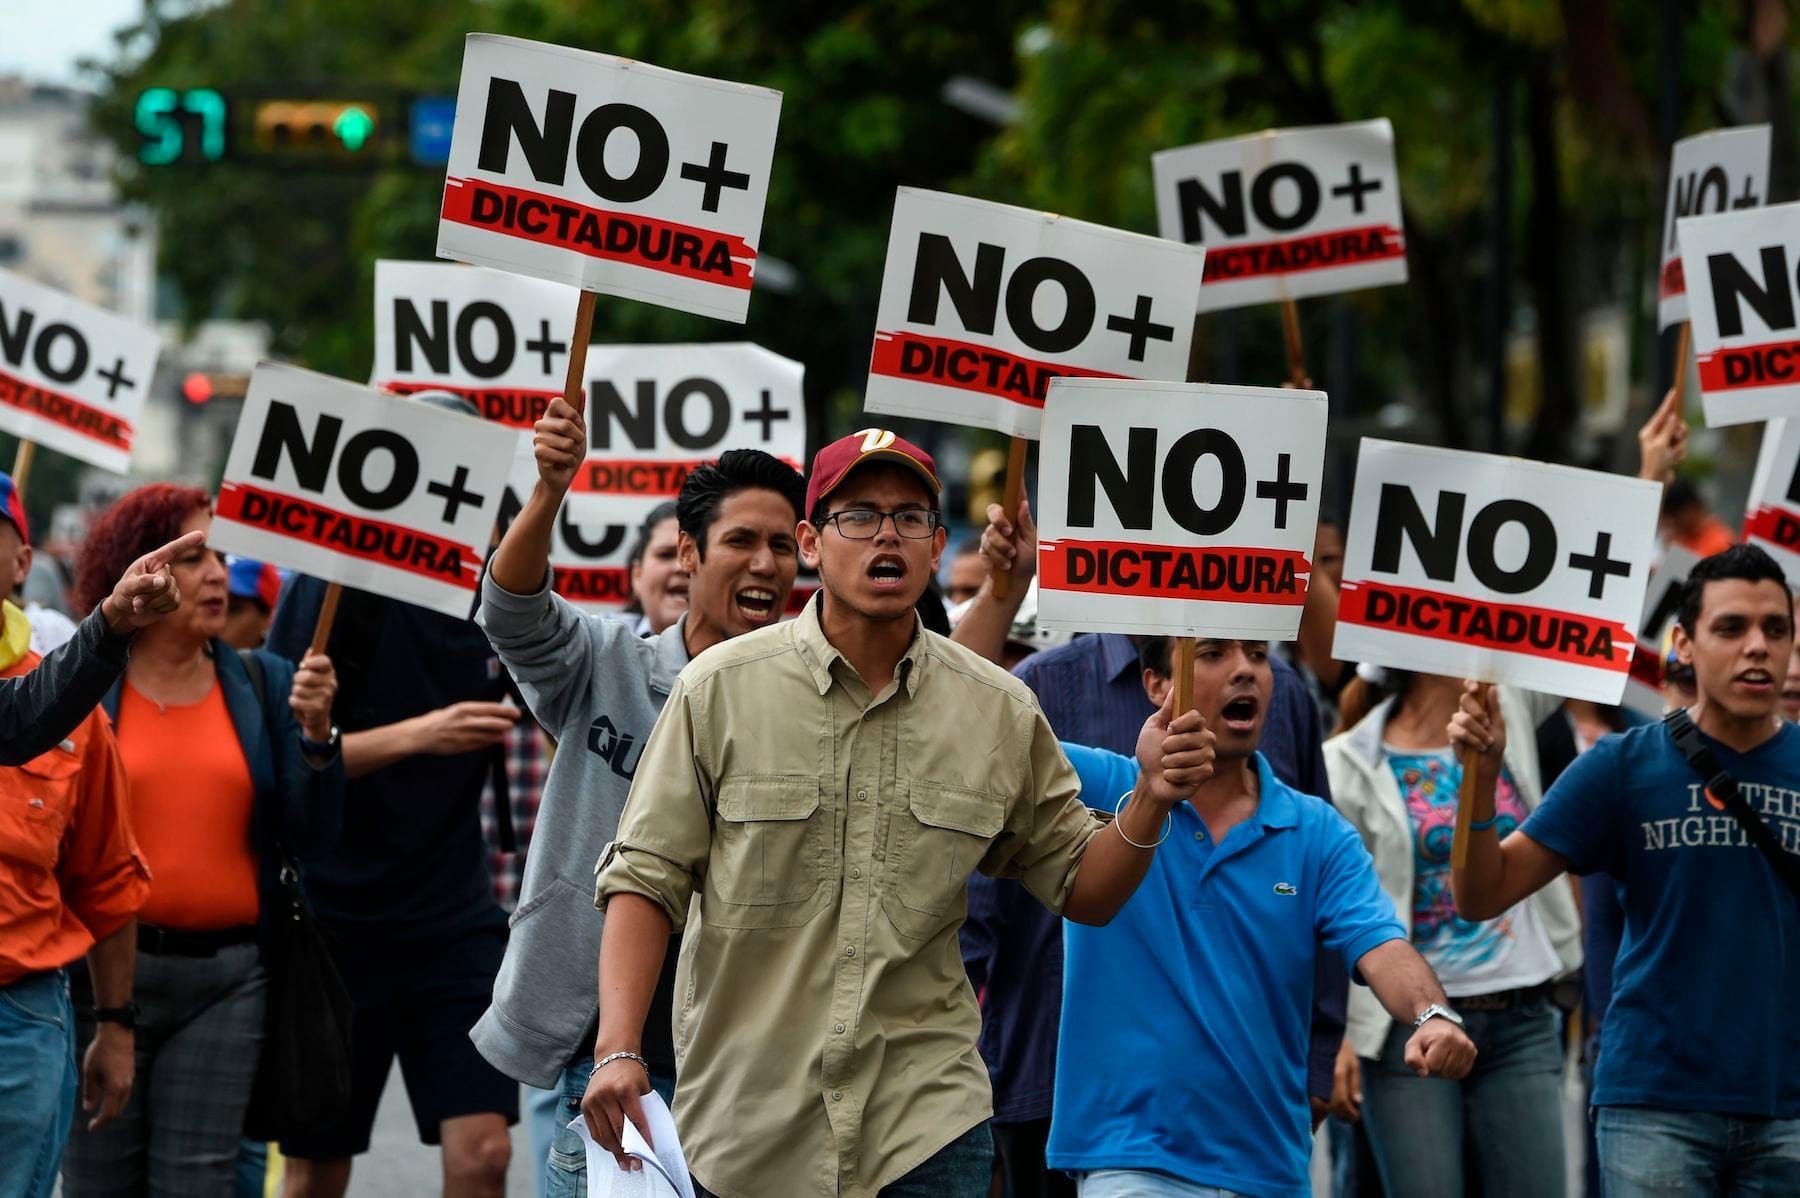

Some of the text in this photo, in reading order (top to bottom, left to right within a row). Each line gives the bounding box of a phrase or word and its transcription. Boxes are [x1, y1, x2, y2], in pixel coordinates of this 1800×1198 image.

[470, 187, 734, 278] DICTADURA
[1204, 231, 1388, 281] ICTADURA
[239, 491, 463, 579] DICTADURA
[1066, 547, 1299, 595] DICTADURA
[1364, 589, 1613, 661] DICTADURA
[1687, 784, 1702, 811] I
